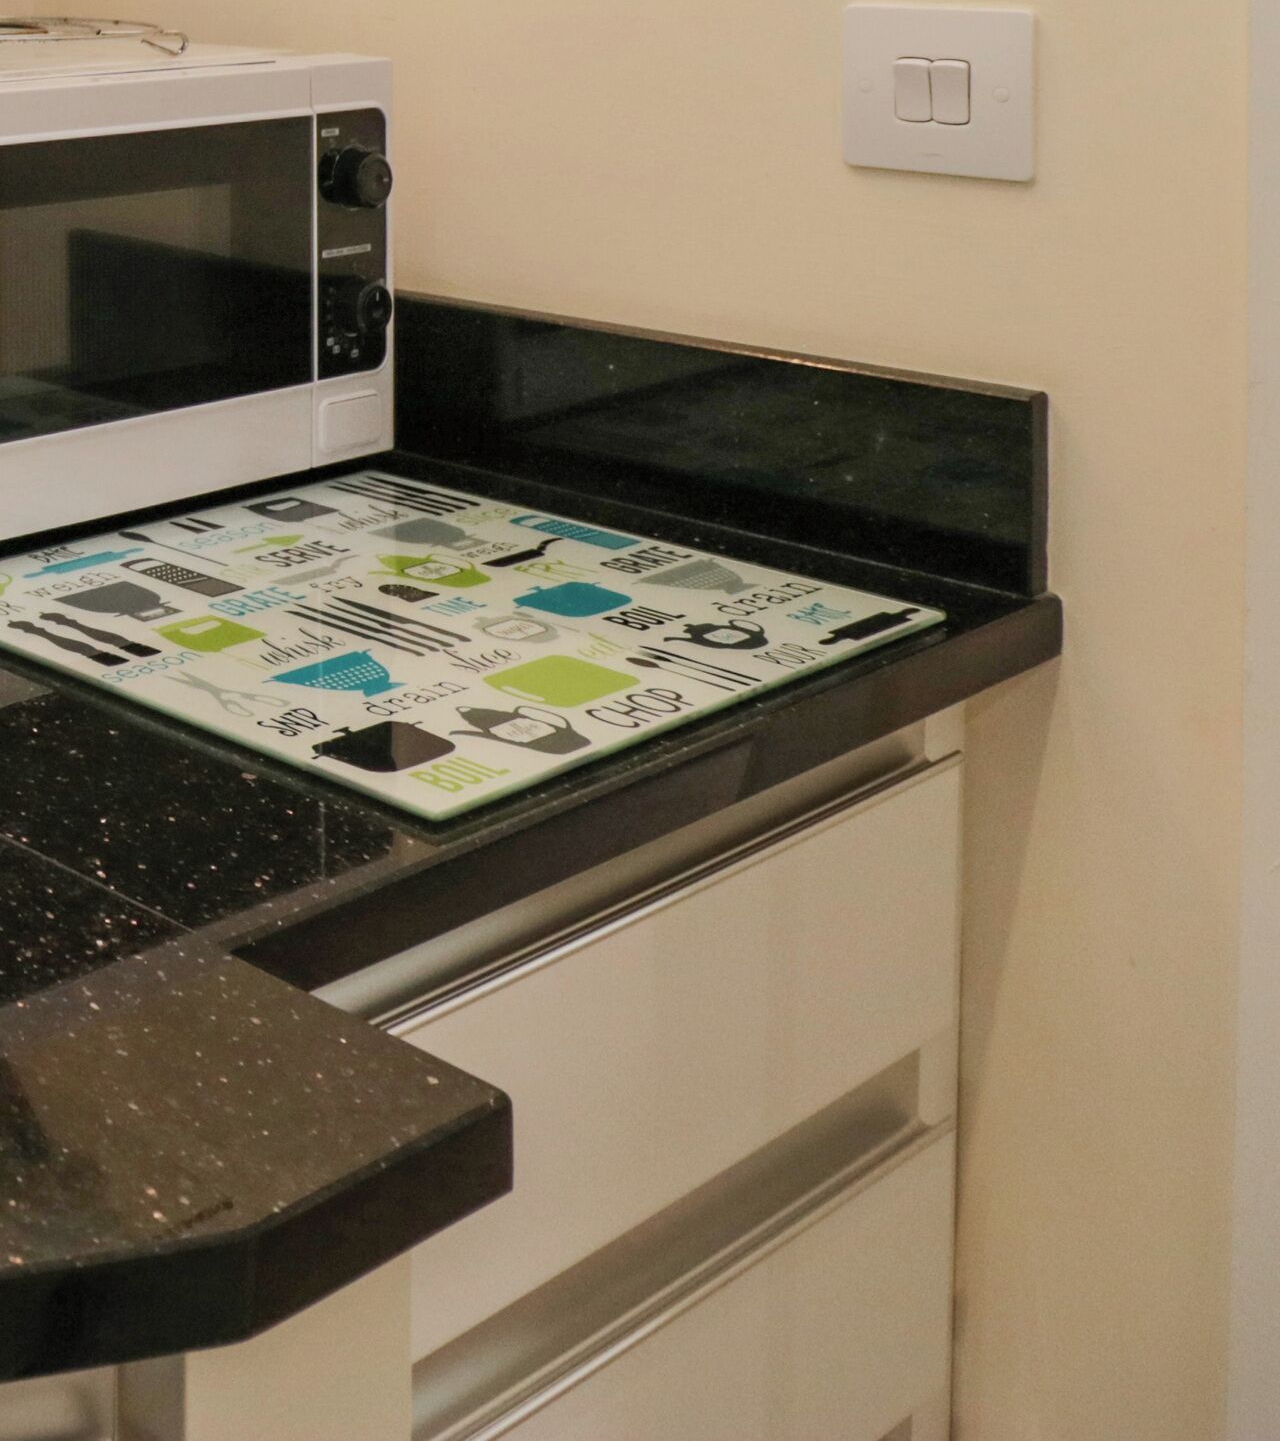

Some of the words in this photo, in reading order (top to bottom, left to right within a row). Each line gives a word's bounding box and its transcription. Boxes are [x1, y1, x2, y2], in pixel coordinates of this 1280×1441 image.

[333, 503, 408, 530] whisk
[179, 521, 283, 550] season
[254, 540, 351, 568] SERVE
[600, 546, 693, 574] GRATE
[23, 571, 122, 598] weigh
[513, 559, 600, 583] FRY
[208, 586, 307, 617] GRATE
[420, 596, 488, 617] TIME
[711, 581, 823, 616] drain
[602, 606, 686, 631] BOIL
[260, 628, 347, 667] whisk
[441, 648, 522, 674] slice
[753, 643, 828, 669] POUR
[101, 649, 206, 683] season
[363, 681, 470, 718] drain
[585, 688, 695, 729] CHOP
[256, 707, 330, 737] SNIP
[408, 757, 512, 794] BOIL
